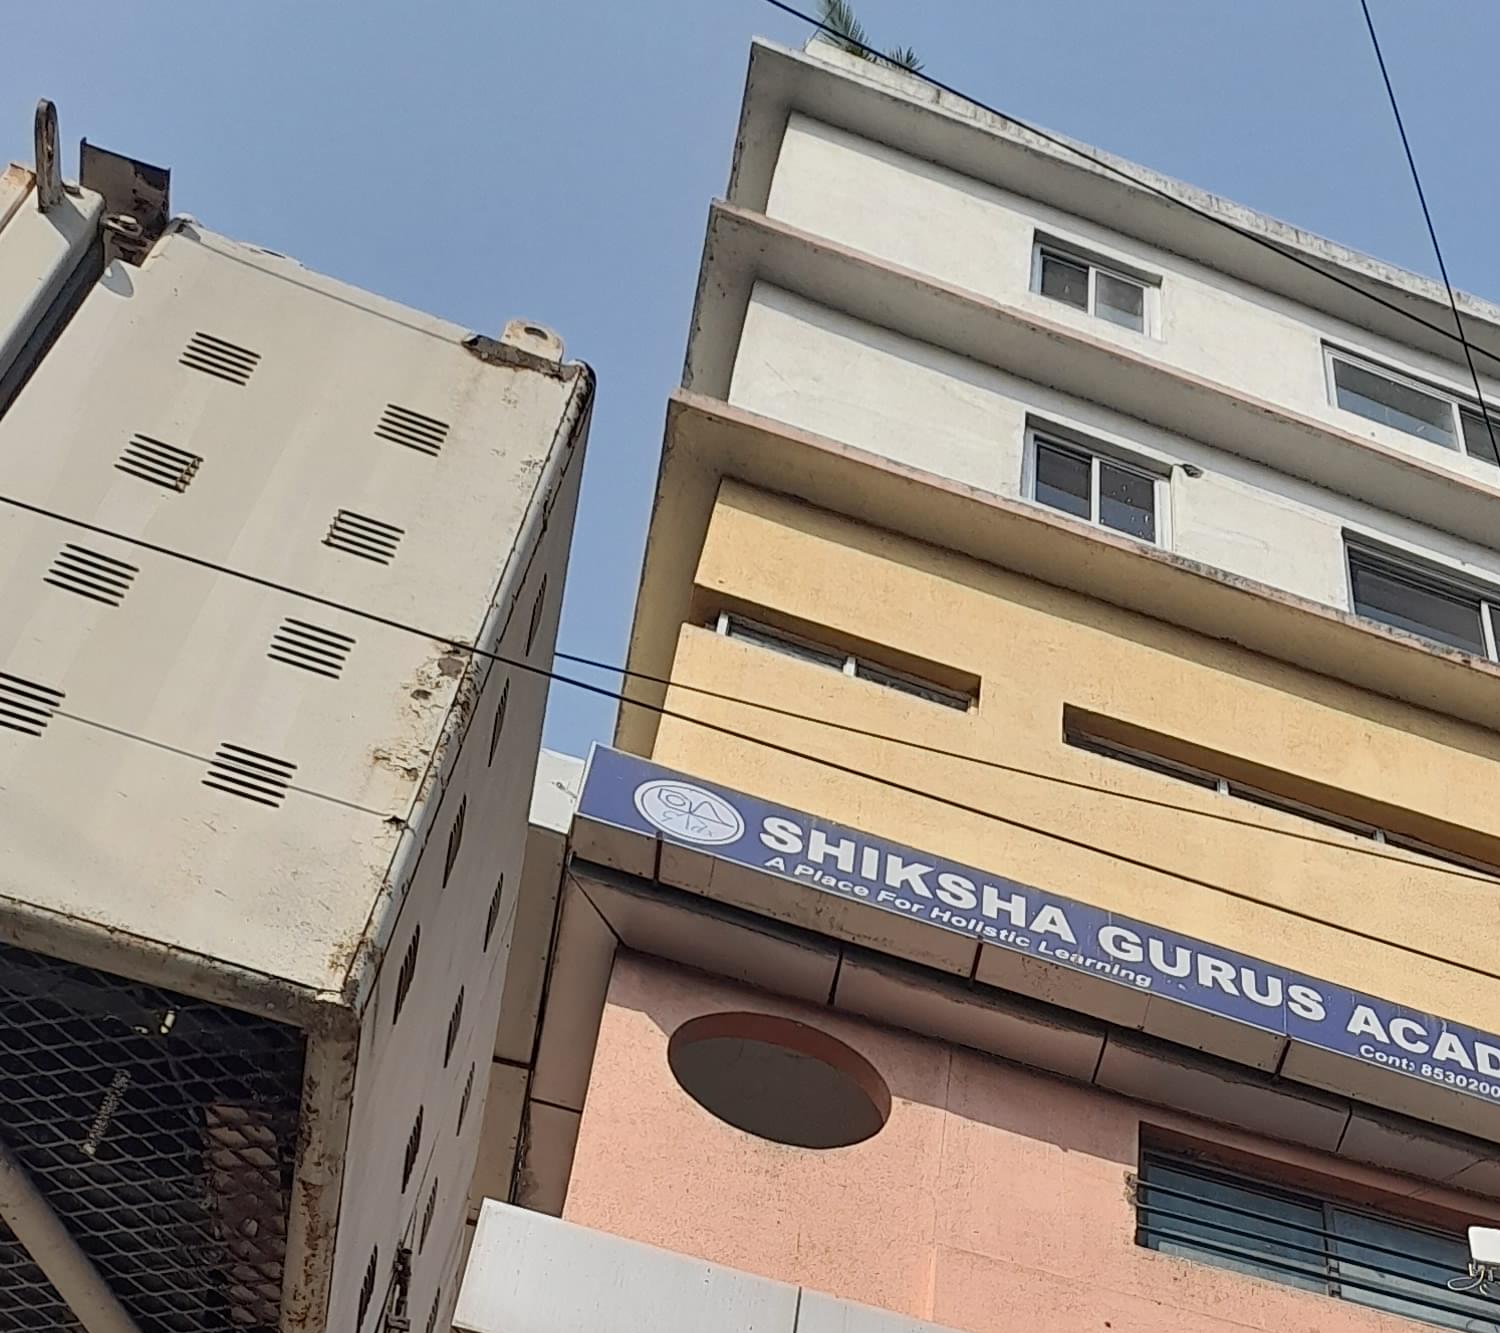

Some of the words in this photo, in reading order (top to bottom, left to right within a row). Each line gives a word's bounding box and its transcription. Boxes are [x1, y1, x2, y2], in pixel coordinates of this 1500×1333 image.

[758, 816, 1078, 945] SHIKSHA
[1098, 924, 1327, 1021] GURUS
[764, 856, 785, 871] A
[793, 863, 869, 897] Place
[877, 890, 926, 914] For
[930, 906, 1031, 948] Holistic
[1038, 941, 1152, 989] Learning
